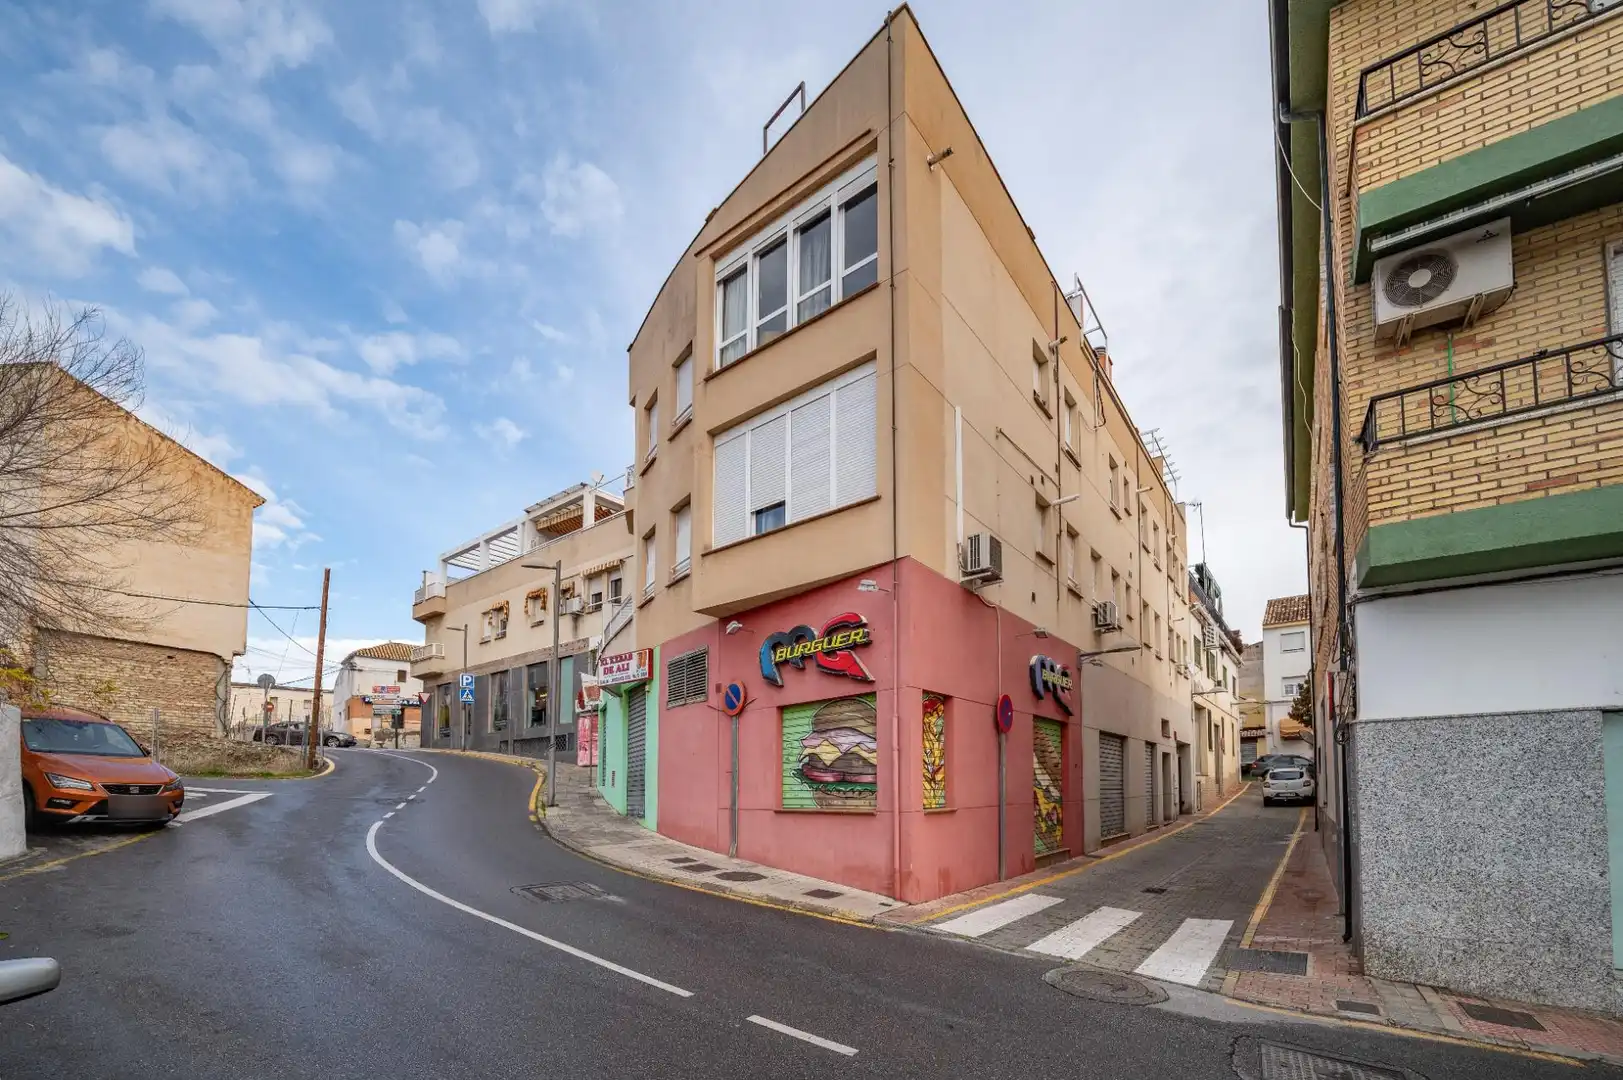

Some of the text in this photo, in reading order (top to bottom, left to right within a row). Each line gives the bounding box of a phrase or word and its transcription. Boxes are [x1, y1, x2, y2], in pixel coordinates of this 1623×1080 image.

[774, 627, 864, 662] BURGUER
[603, 662, 630, 676] DE ALI
[462, 675, 472, 686] P
[1041, 668, 1073, 690] BURGUER
